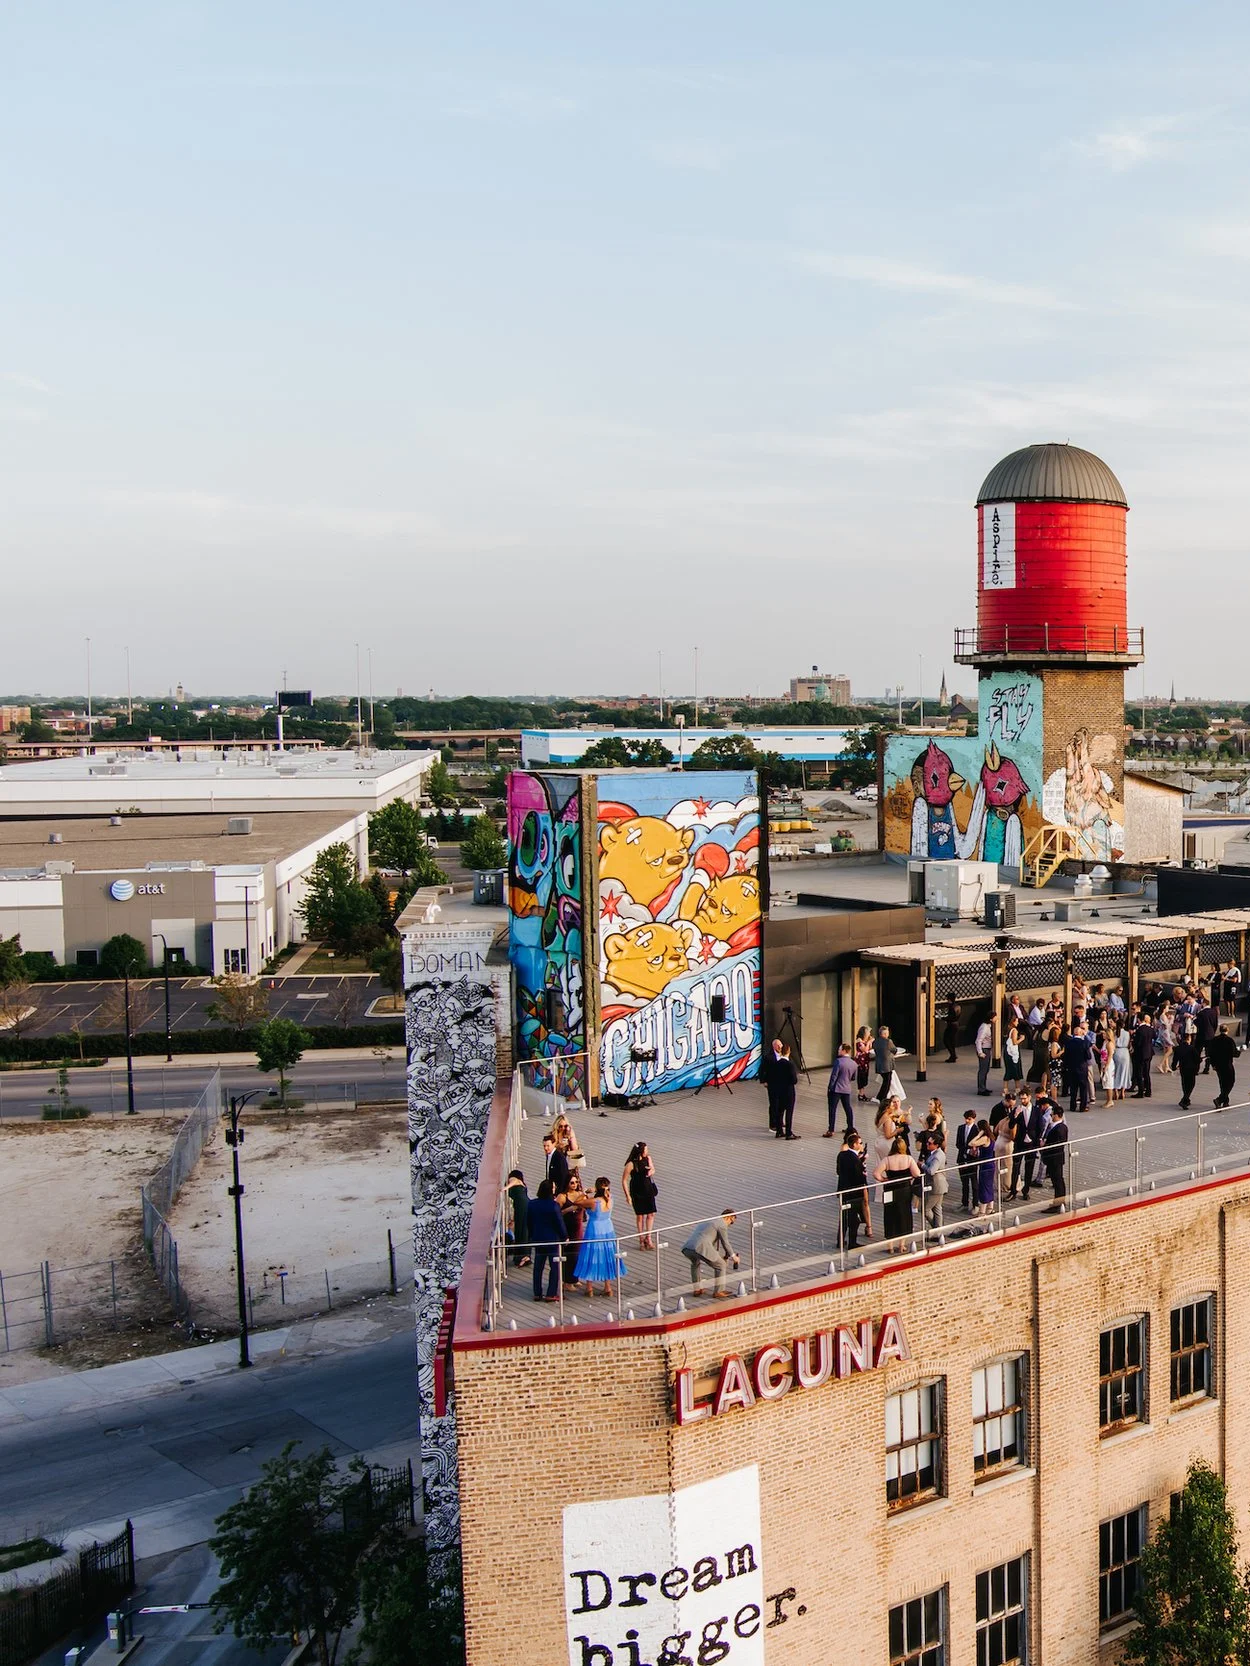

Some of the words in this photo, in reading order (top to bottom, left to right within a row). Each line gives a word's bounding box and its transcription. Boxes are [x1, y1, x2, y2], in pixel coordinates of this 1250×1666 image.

[992, 507, 1003, 585] Aspire.
[986, 702, 1034, 743] FLY
[992, 682, 1031, 707] STAY
[137, 883, 166, 895] at&t
[604, 962, 755, 1094] CHICAGO
[676, 1311, 912, 1426] LACUNA
[570, 1543, 758, 1614] Dream
